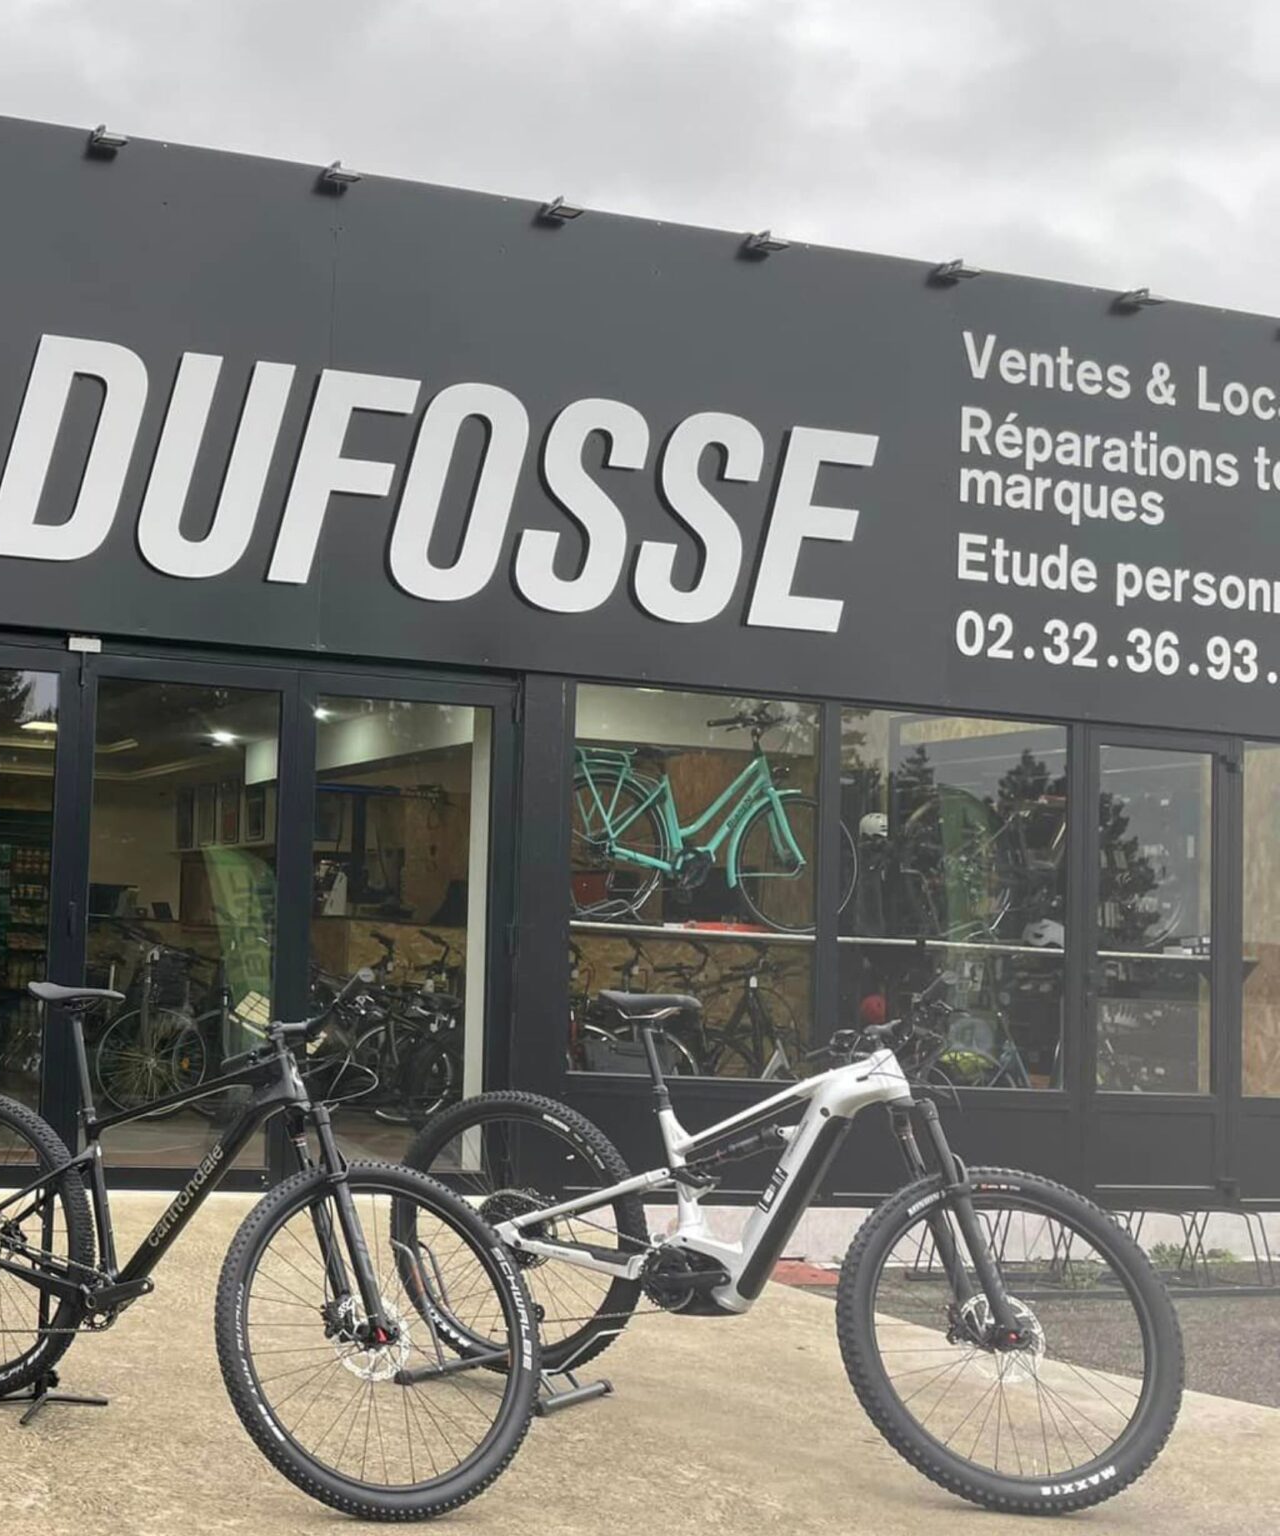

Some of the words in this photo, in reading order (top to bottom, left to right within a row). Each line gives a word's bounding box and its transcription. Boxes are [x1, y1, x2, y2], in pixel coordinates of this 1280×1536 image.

[962, 331, 1131, 399] Ventes
[1146, 362, 1176, 406] &
[1198, 366, 1280, 420] Loc
[960, 405, 1239, 487] Réparations
[960, 467, 1165, 525] marques
[957, 532, 1097, 592] Etude
[149, 1141, 224, 1247] cannondale
[491, 1246, 532, 1371] SCHWALBE
[1040, 1465, 1117, 1496] MAXXIS
